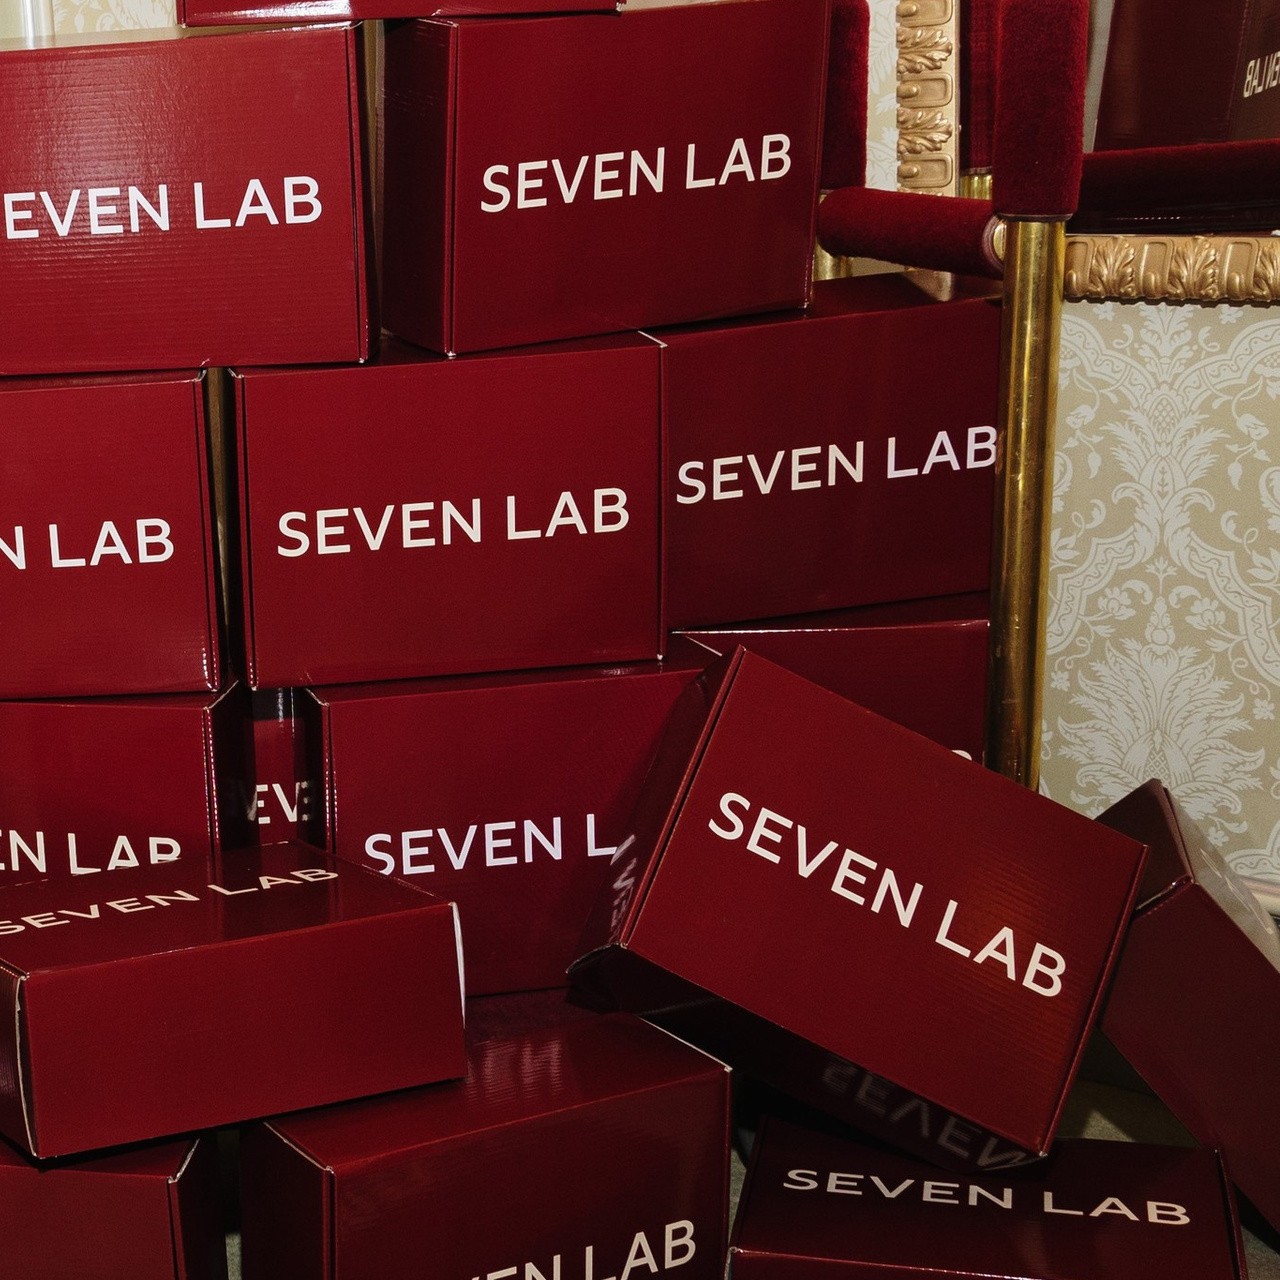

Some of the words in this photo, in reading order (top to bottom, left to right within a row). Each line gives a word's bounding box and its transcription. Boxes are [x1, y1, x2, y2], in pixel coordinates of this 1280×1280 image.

[481, 147, 665, 212] SEVEN
[686, 134, 791, 189] LAB
[194, 176, 322, 229] LAB
[677, 441, 864, 504] SEVEN
[887, 426, 997, 478] LAB
[49, 518, 174, 568] LAB
[278, 498, 481, 557] SEVEN
[507, 488, 629, 540] LAB
[365, 817, 562, 875] SEVEN
[208, 869, 338, 895] LAB
[709, 793, 923, 928] SEVEN
[935, 900, 1065, 997] LAB
[784, 1170, 1012, 1209] SEVEN
[1044, 1192, 1190, 1225] LAB
